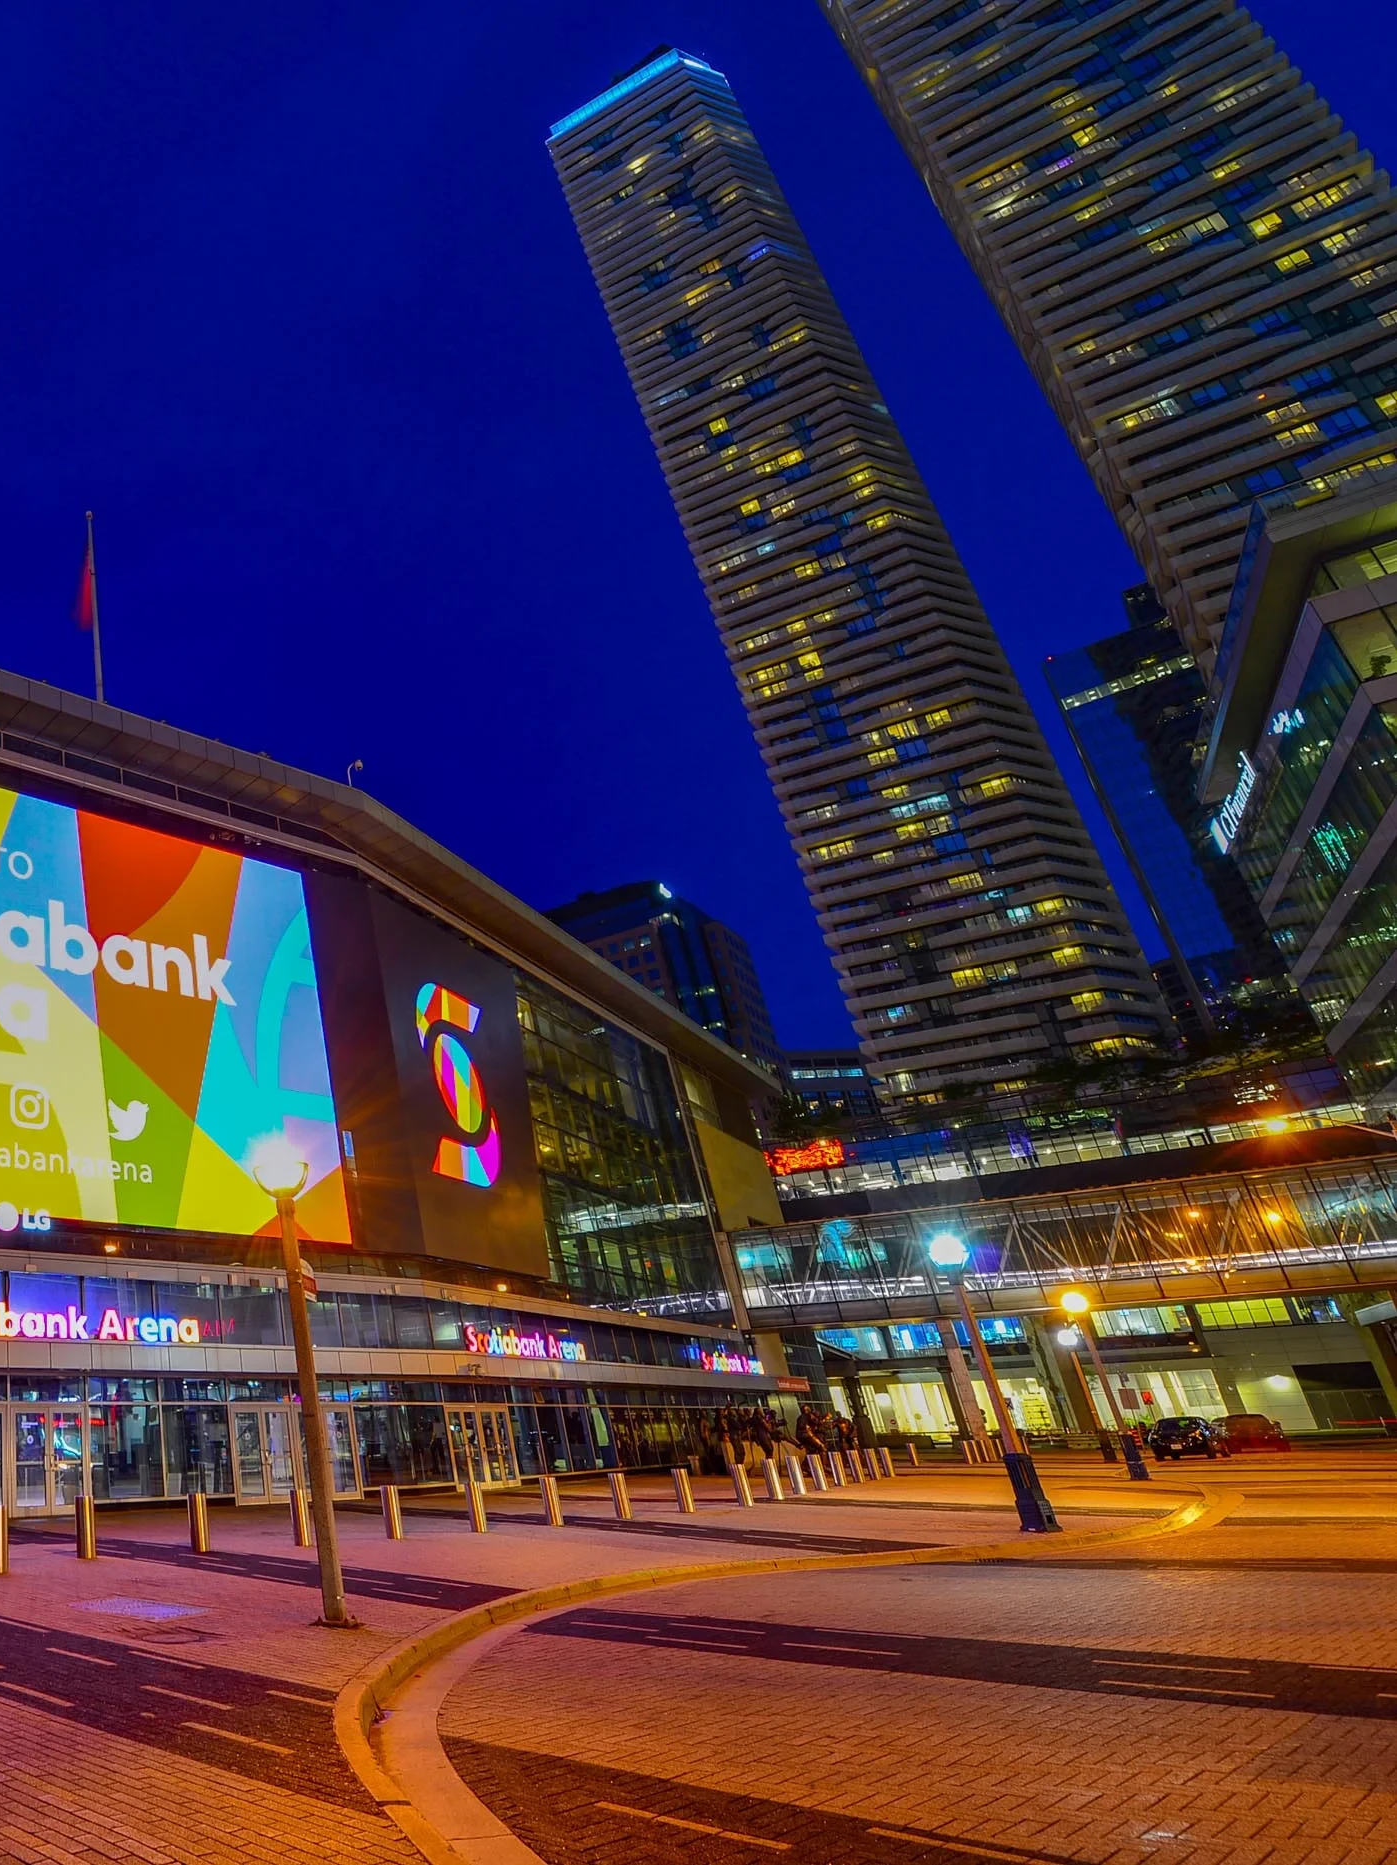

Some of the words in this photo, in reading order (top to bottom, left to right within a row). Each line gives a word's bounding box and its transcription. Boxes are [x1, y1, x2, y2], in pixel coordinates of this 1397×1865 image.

[22, 1208, 51, 1231] LG
[97, 1308, 201, 1344] Arena
[464, 1325, 547, 1358] Scotiabank
[547, 1333, 587, 1361] Arena
